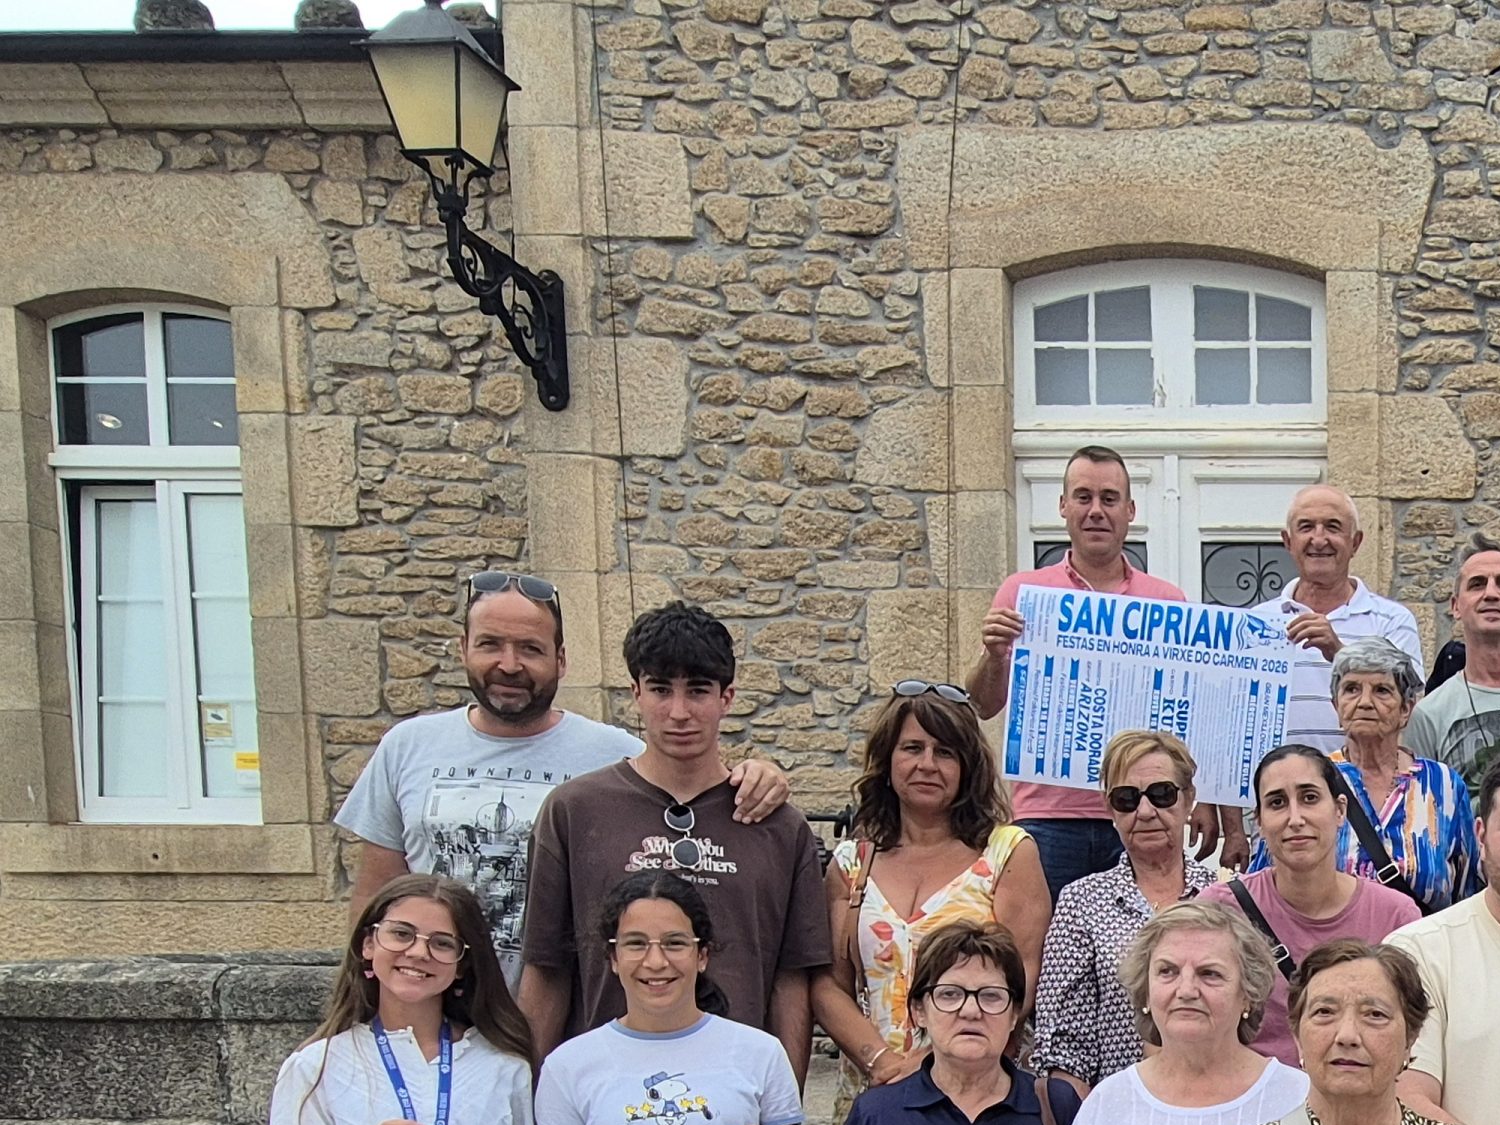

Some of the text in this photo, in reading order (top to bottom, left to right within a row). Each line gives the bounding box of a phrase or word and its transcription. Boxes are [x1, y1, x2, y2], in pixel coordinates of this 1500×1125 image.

[1058, 594, 1234, 650] SAN CIPRIAN
[1056, 635, 1288, 674] FESTAS EN HONRA A VIRXE DO CARMEN 2026
[1075, 683, 1092, 752] ARIZONA
[1087, 688, 1107, 784] COSTA DORADA
